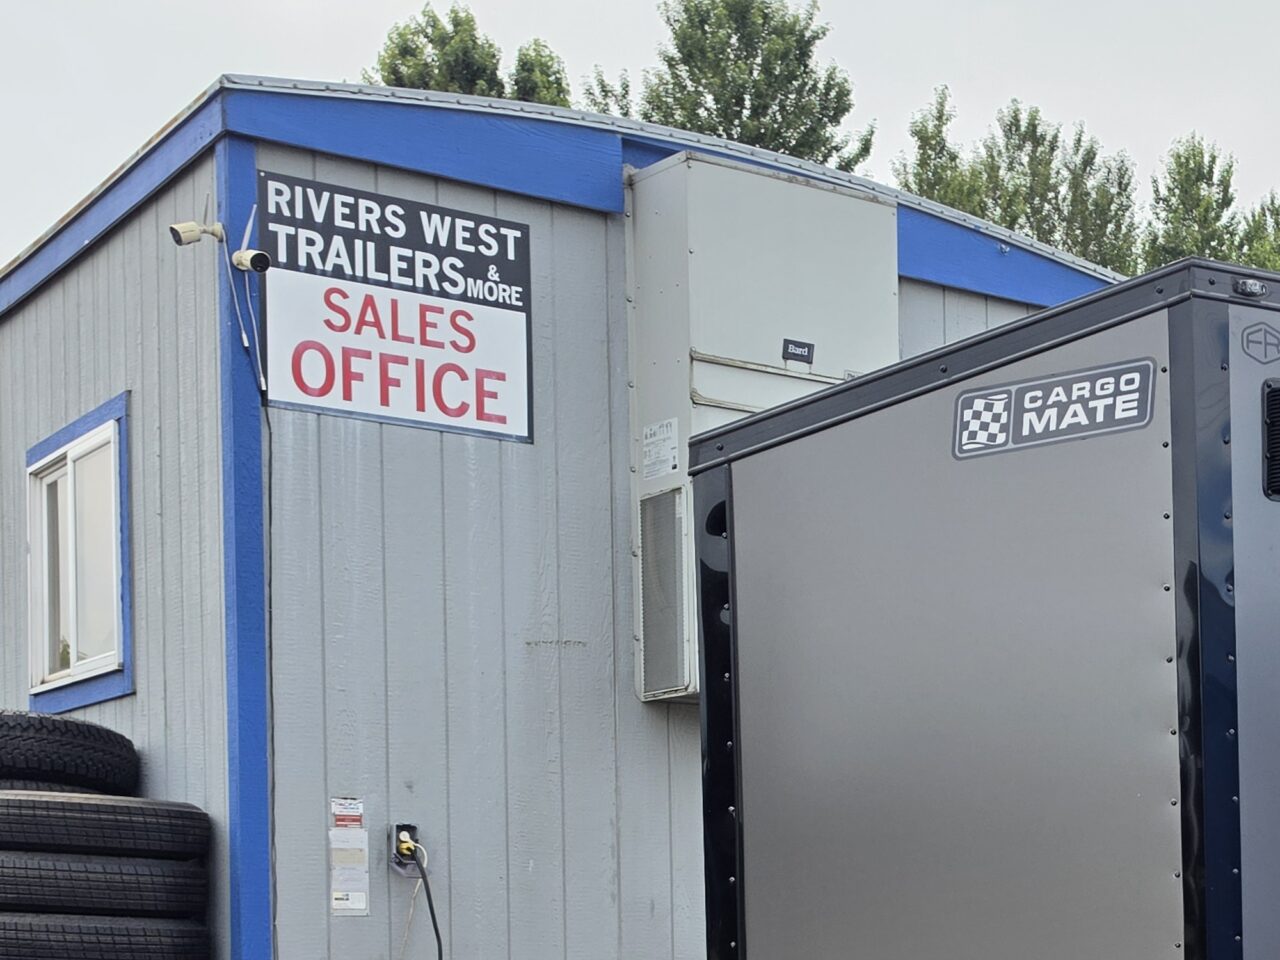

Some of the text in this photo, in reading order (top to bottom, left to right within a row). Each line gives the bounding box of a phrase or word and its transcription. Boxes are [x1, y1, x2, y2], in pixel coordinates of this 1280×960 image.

[267, 180, 521, 260] RIVERS WEST
[268, 223, 523, 306] TRAILERS & MORE
[323, 287, 476, 353] SALES
[788, 344, 808, 355] Bard
[291, 340, 507, 424] OFFICE
[1022, 392, 1140, 436] MATE
[1023, 372, 1140, 409] CARGO
